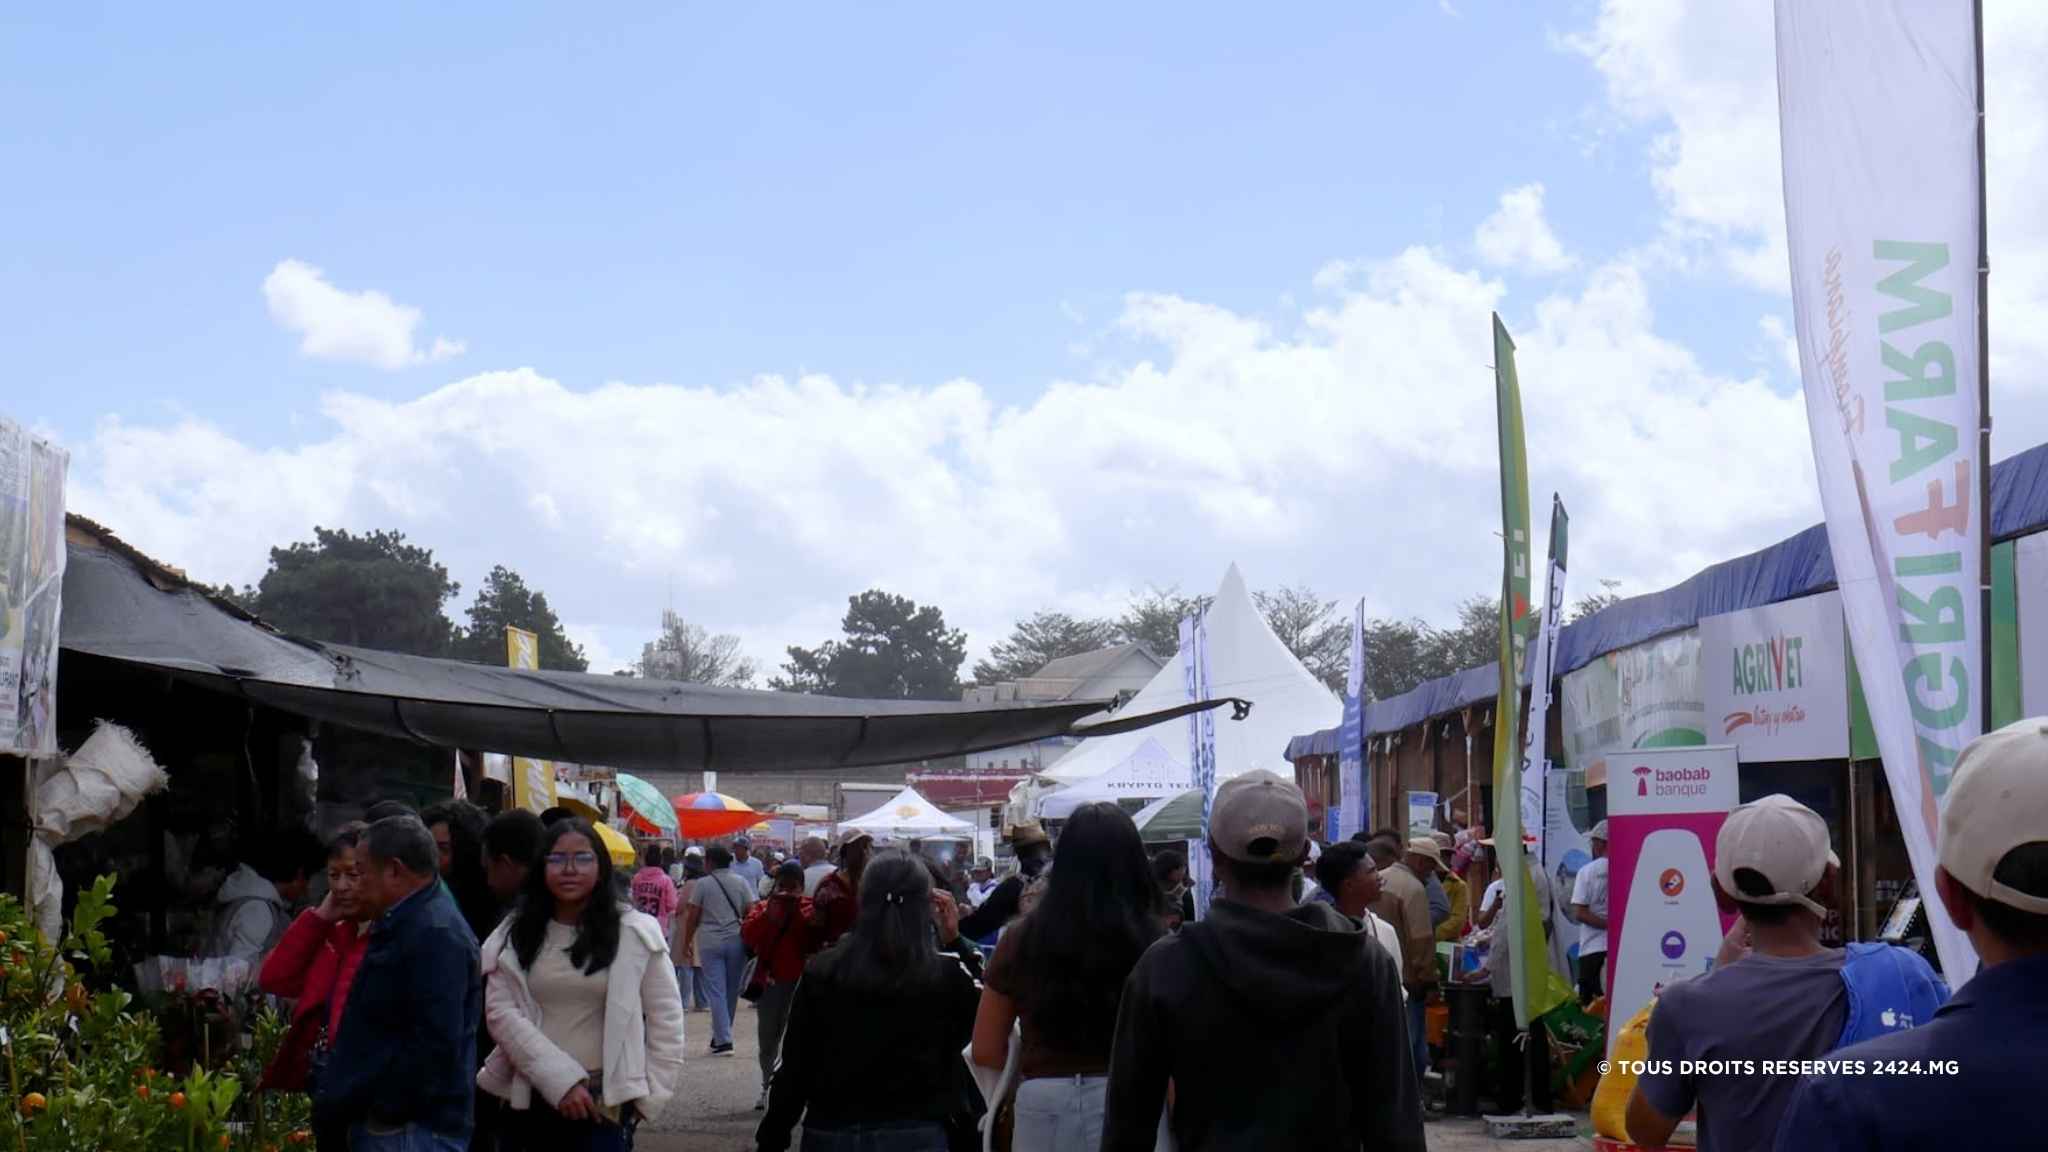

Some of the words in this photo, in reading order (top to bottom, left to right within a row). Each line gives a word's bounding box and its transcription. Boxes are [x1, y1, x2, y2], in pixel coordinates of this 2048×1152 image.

[1733, 629, 1802, 695] AGRIVET
[1656, 767, 1710, 781] baobab
[1656, 781, 1707, 797] banque
